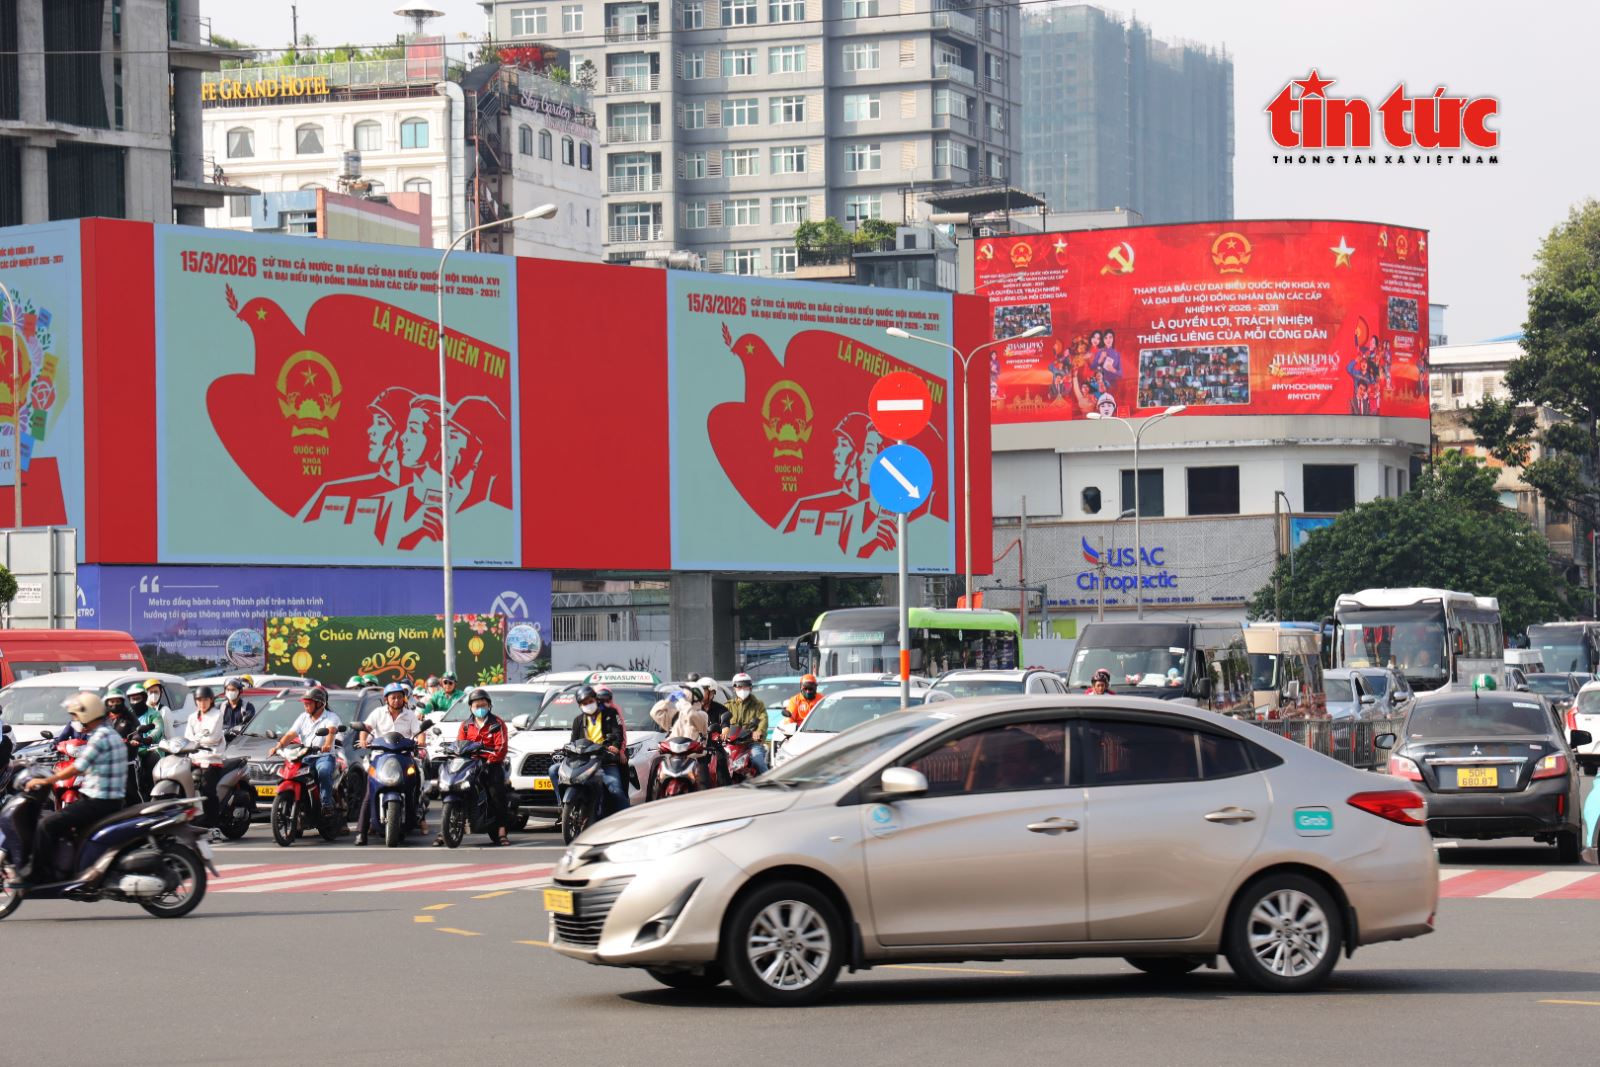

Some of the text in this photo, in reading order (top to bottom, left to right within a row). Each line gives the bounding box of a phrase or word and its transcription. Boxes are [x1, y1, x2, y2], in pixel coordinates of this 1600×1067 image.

[220, 75, 330, 100] GRAND HOTEL
[521, 88, 540, 112] Sky
[180, 250, 257, 277] 15/3/2026
[262, 256, 275, 267] CỬ
[278, 259, 291, 268] TRI
[294, 258, 306, 270] CẢ
[308, 260, 333, 272] NƯỚC
[336, 264, 345, 273] ĐI
[347, 264, 365, 275] BẦU
[367, 264, 378, 275] CỬ
[381, 268, 396, 280] ĐẠI
[398, 267, 418, 279] BIỂU
[445, 272, 459, 283] HỘI
[486, 276, 500, 286] XVI
[263, 270, 273, 280] VÀ
[275, 272, 288, 282] ĐẠI
[290, 272, 307, 282] BIỂU
[310, 274, 322, 286] HỘI
[324, 275, 345, 285] ĐỒNG
[347, 276, 368, 287] NHÂN
[370, 278, 385, 288] DÂN
[387, 280, 401, 290] CÁC
[404, 280, 418, 292] CẤP
[480, 288, 500, 298] 2031!
[1133, 286, 1157, 295] THAM
[1174, 283, 1192, 292] BẦU
[1194, 282, 1206, 291] CỬ
[1208, 282, 1223, 291] ĐẠI
[1225, 280, 1245, 290] BIỂU
[1248, 280, 1272, 290] QUỐC
[1275, 280, 1290, 290] HỘI
[687, 293, 746, 316] 15/3/2026
[751, 296, 761, 306] CỬ
[763, 299, 774, 308] TRI
[776, 298, 785, 308] CẢ
[787, 300, 806, 310] NƯỚC
[818, 302, 832, 313] BẦU
[875, 307, 894, 317] QUỐC
[1142, 291, 1322, 305] VÀ ĐẠI BIỂU HỘI ĐỒNG NHÂN DÂN CÁC CẤP
[1185, 305, 1213, 314] NHIỆM
[1152, 314, 1313, 329] LÀ QUYỀN LỢI, TRÁCH NHIỆM
[372, 306, 391, 332] LÁ
[394, 314, 438, 350] PHIẾU
[483, 351, 506, 379] TIN
[1137, 326, 1328, 344] THIÊNG LIÊNG CỦA MỖI CÔNG DÂN
[838, 340, 853, 363] LÁ
[293, 444, 314, 455] QUỐC
[303, 465, 321, 475] XVI
[782, 483, 797, 492] XVI
[1107, 547, 1165, 567] USAC
[1076, 570, 1178, 594] Chropractic
[148, 596, 323, 607] Metro đồng hành cùng Thành phố trên hành trình
[77, 608, 94, 617] ETRO
[144, 610, 167, 620] hướng
[169, 610, 179, 618] tới
[181, 611, 197, 621] giao
[199, 610, 220, 620] thông
[252, 610, 268, 619] phát
[319, 627, 457, 643] Chúc Mừng Năm Mi
[360, 646, 420, 672] 2026
[1469, 768, 1486, 777] 50H
[1462, 777, 1493, 786] 680.87
